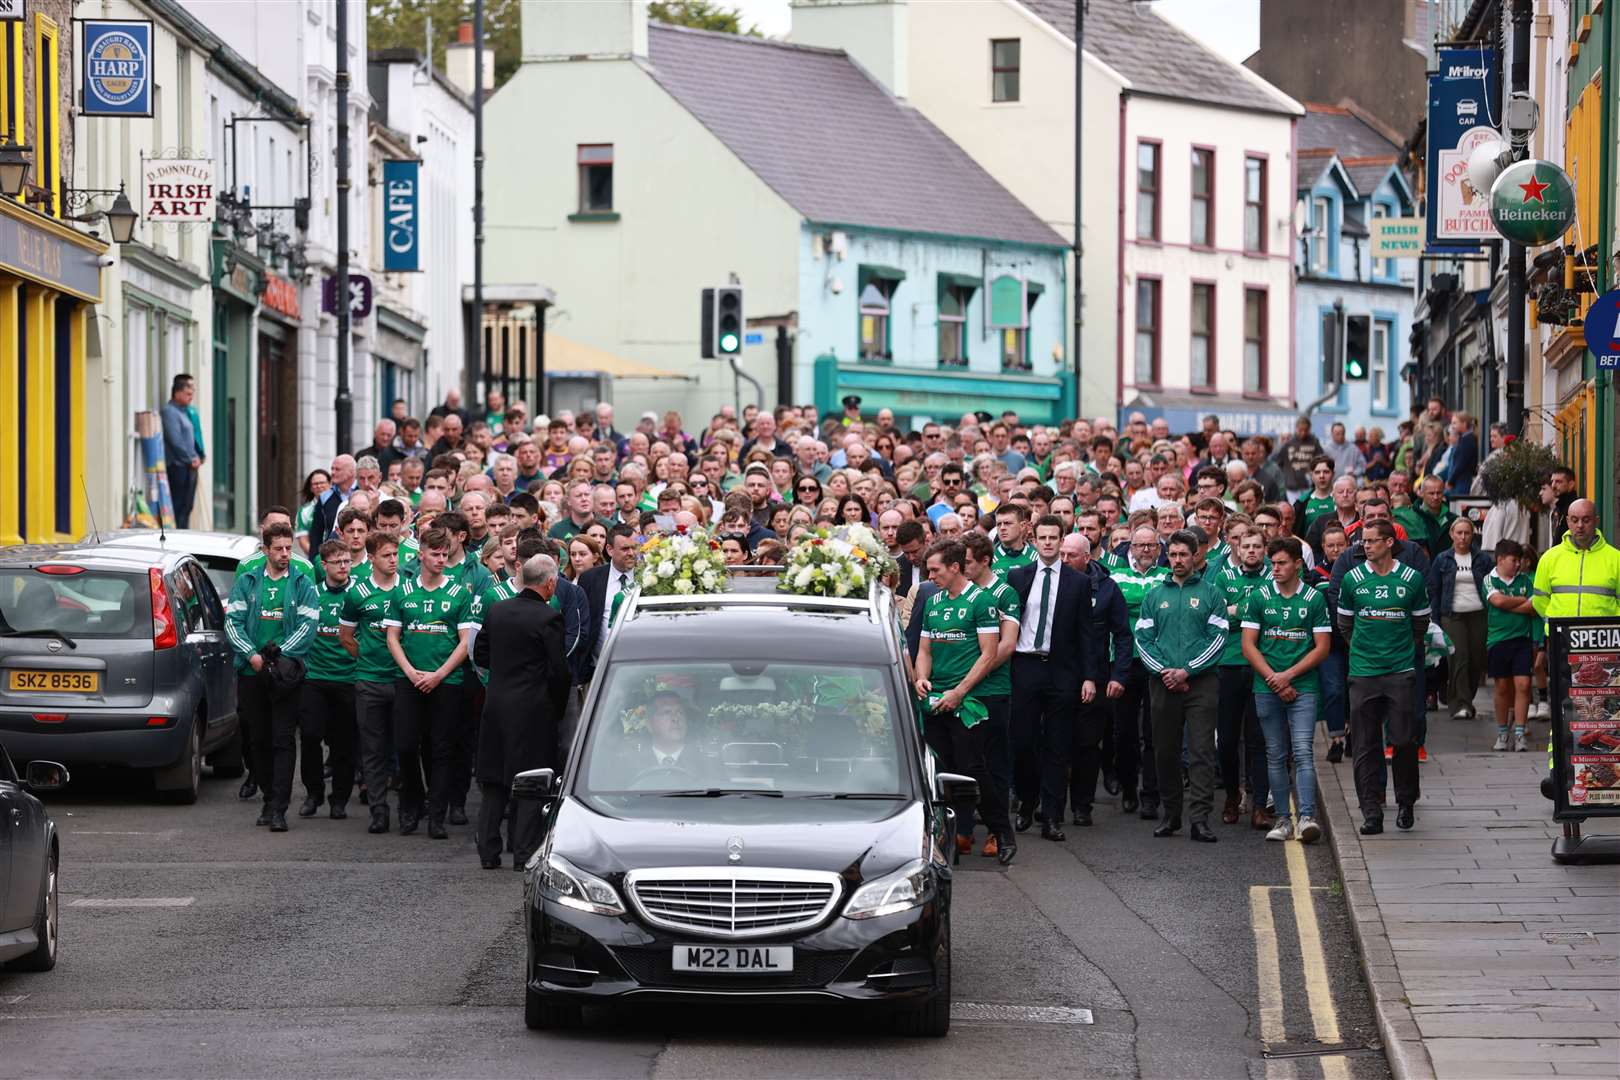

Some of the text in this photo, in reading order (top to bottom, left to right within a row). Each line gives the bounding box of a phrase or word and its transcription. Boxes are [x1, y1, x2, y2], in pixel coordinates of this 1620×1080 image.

[93, 60, 139, 76] HARP
[157, 165, 209, 181] DONNELLY
[148, 184, 212, 199] IRISH
[148, 201, 207, 215] ART
[1499, 208, 1566, 221] Heineken
[389, 180, 413, 253] CAFE
[1381, 225, 1419, 235] IRISH
[1381, 240, 1419, 250] NEWS
[1375, 589, 1389, 599] 24
[330, 607, 337, 616] 4
[423, 603, 433, 613] 14
[943, 611, 951, 621] 6
[1282, 610, 1290, 620] 9
[17, 673, 92, 689] SKZ 8536
[687, 947, 778, 969] M22 DAL
